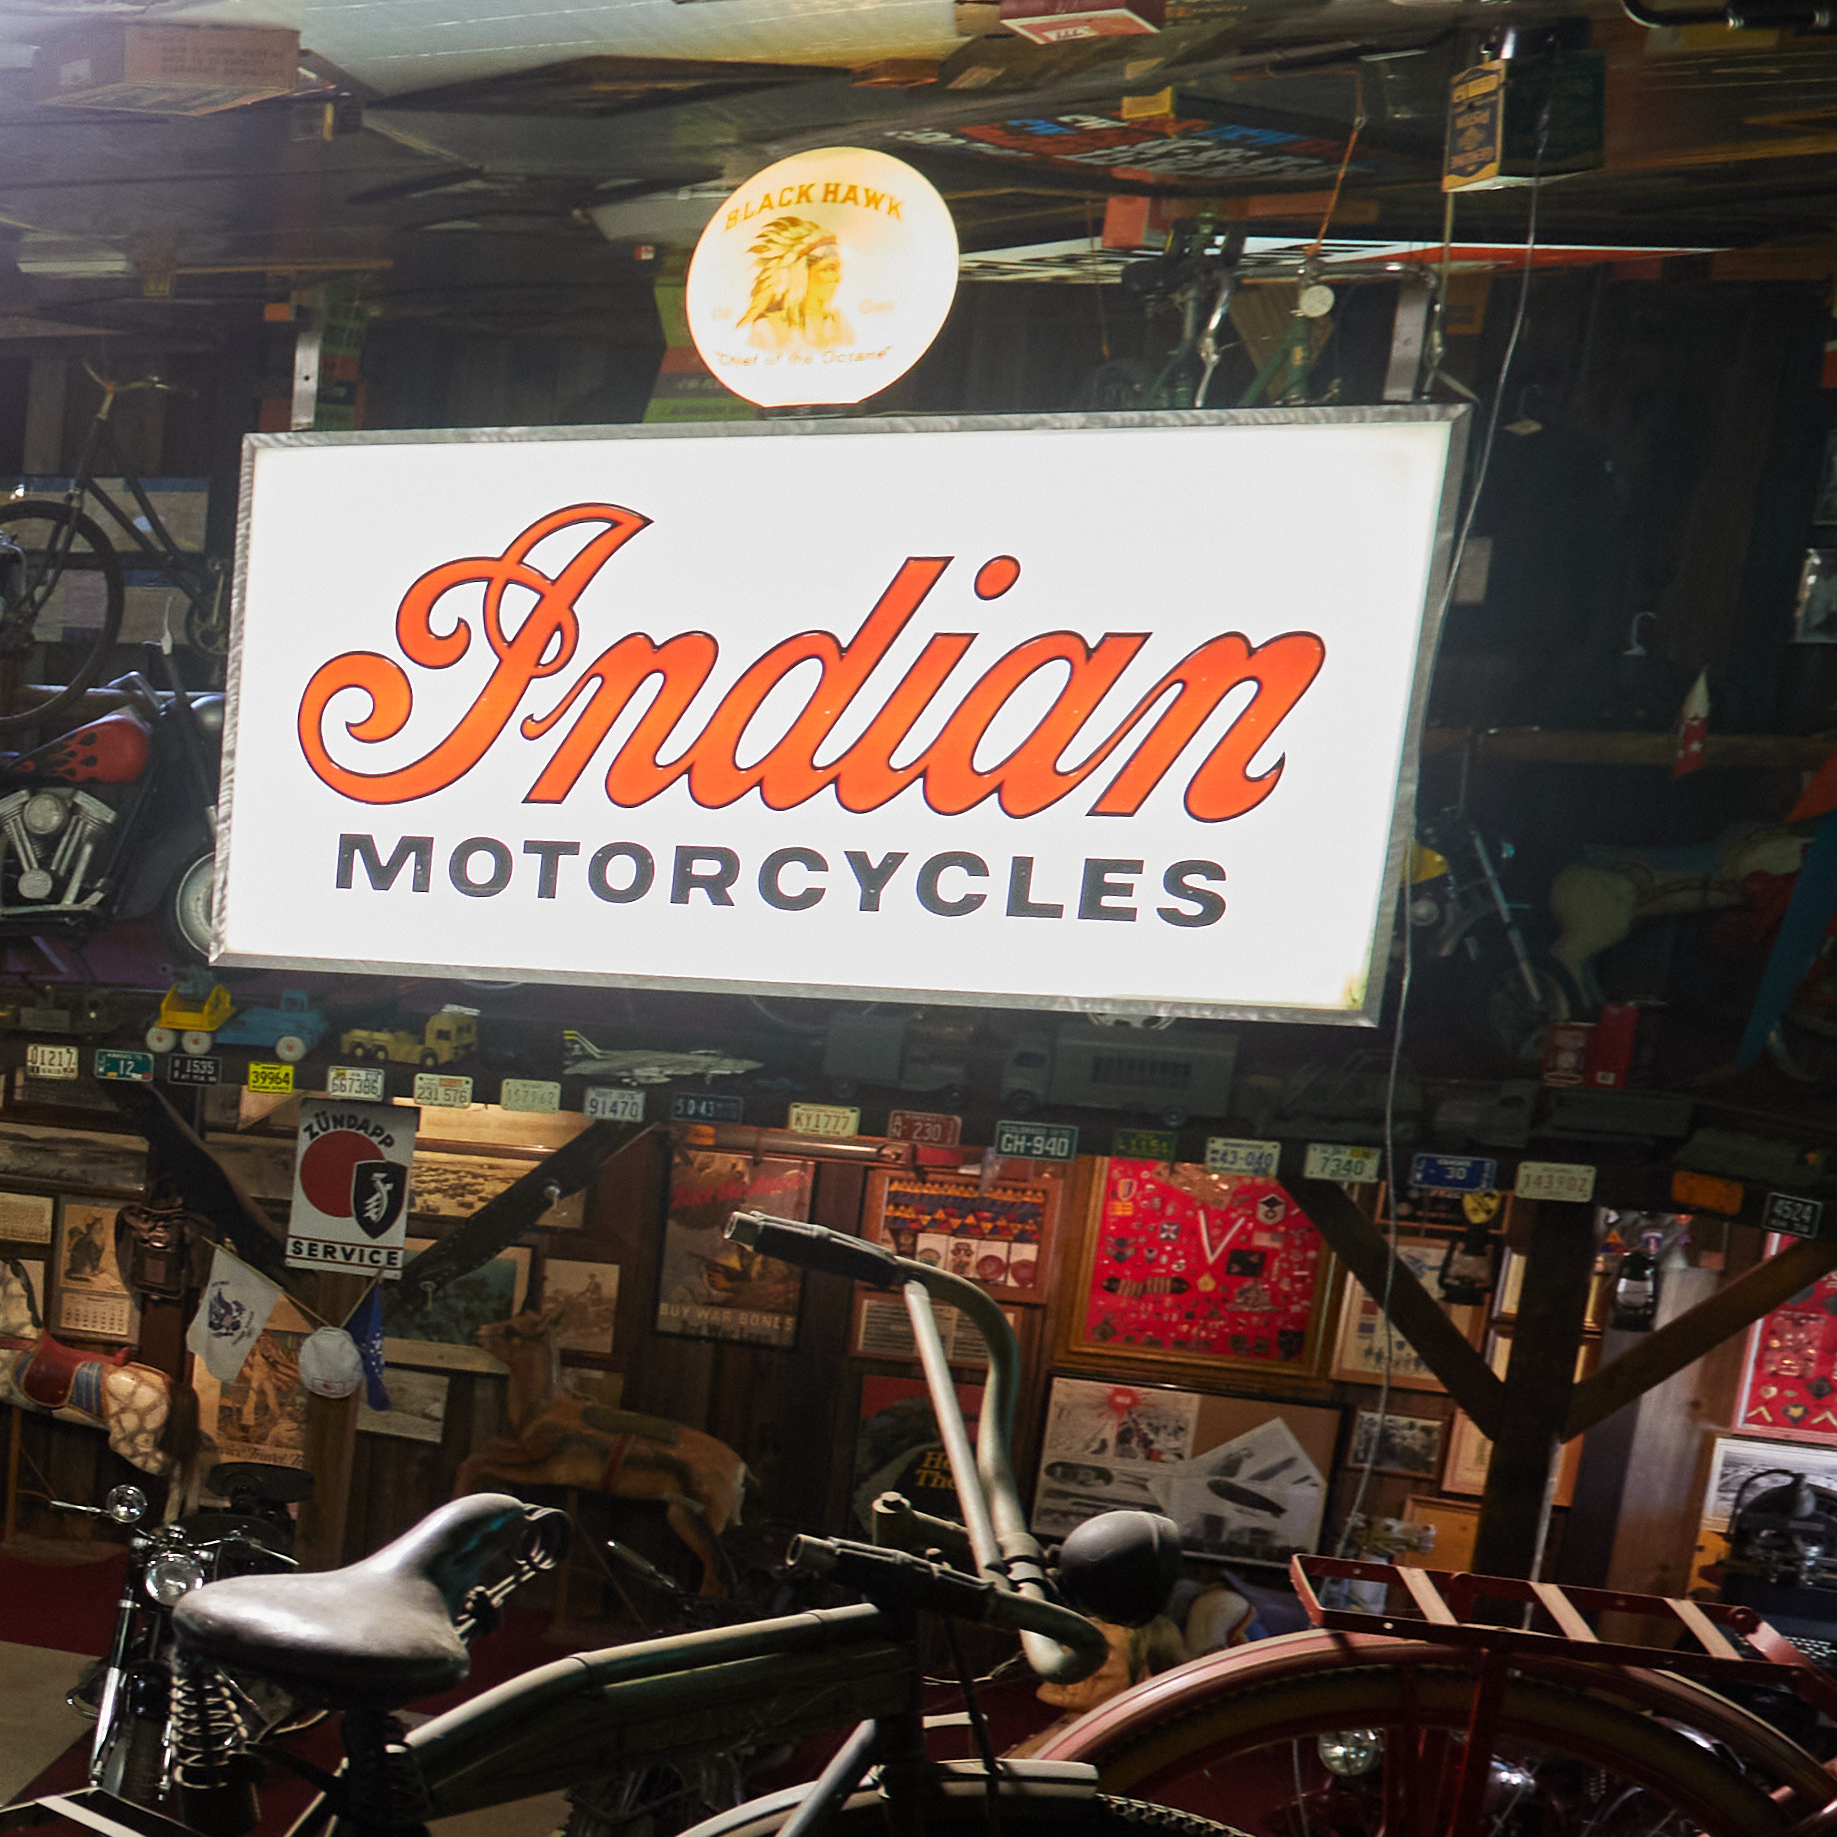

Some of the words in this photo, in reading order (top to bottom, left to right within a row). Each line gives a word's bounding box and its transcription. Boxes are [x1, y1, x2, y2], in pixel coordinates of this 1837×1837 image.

[723, 183, 816, 231] BLACK
[822, 182, 904, 222] HAWK
[297, 502, 1326, 823] Indian
[336, 832, 1229, 928] MOTORCYCLES
[118, 1059, 135, 1076] 12
[185, 1059, 215, 1075] 1535
[251, 1070, 291, 1087] 39964
[417, 1085, 440, 1101] 231
[443, 1089, 469, 1104] 576
[588, 1097, 640, 1118] 91470
[303, 1111, 396, 1148] ZÜNDAPP
[1000, 1132, 1070, 1157] GH-940
[1320, 1155, 1365, 1176] 7340
[292, 1241, 399, 1266] SERVICE
[658, 1302, 693, 1322] BUY
[695, 1306, 733, 1325] WAR
